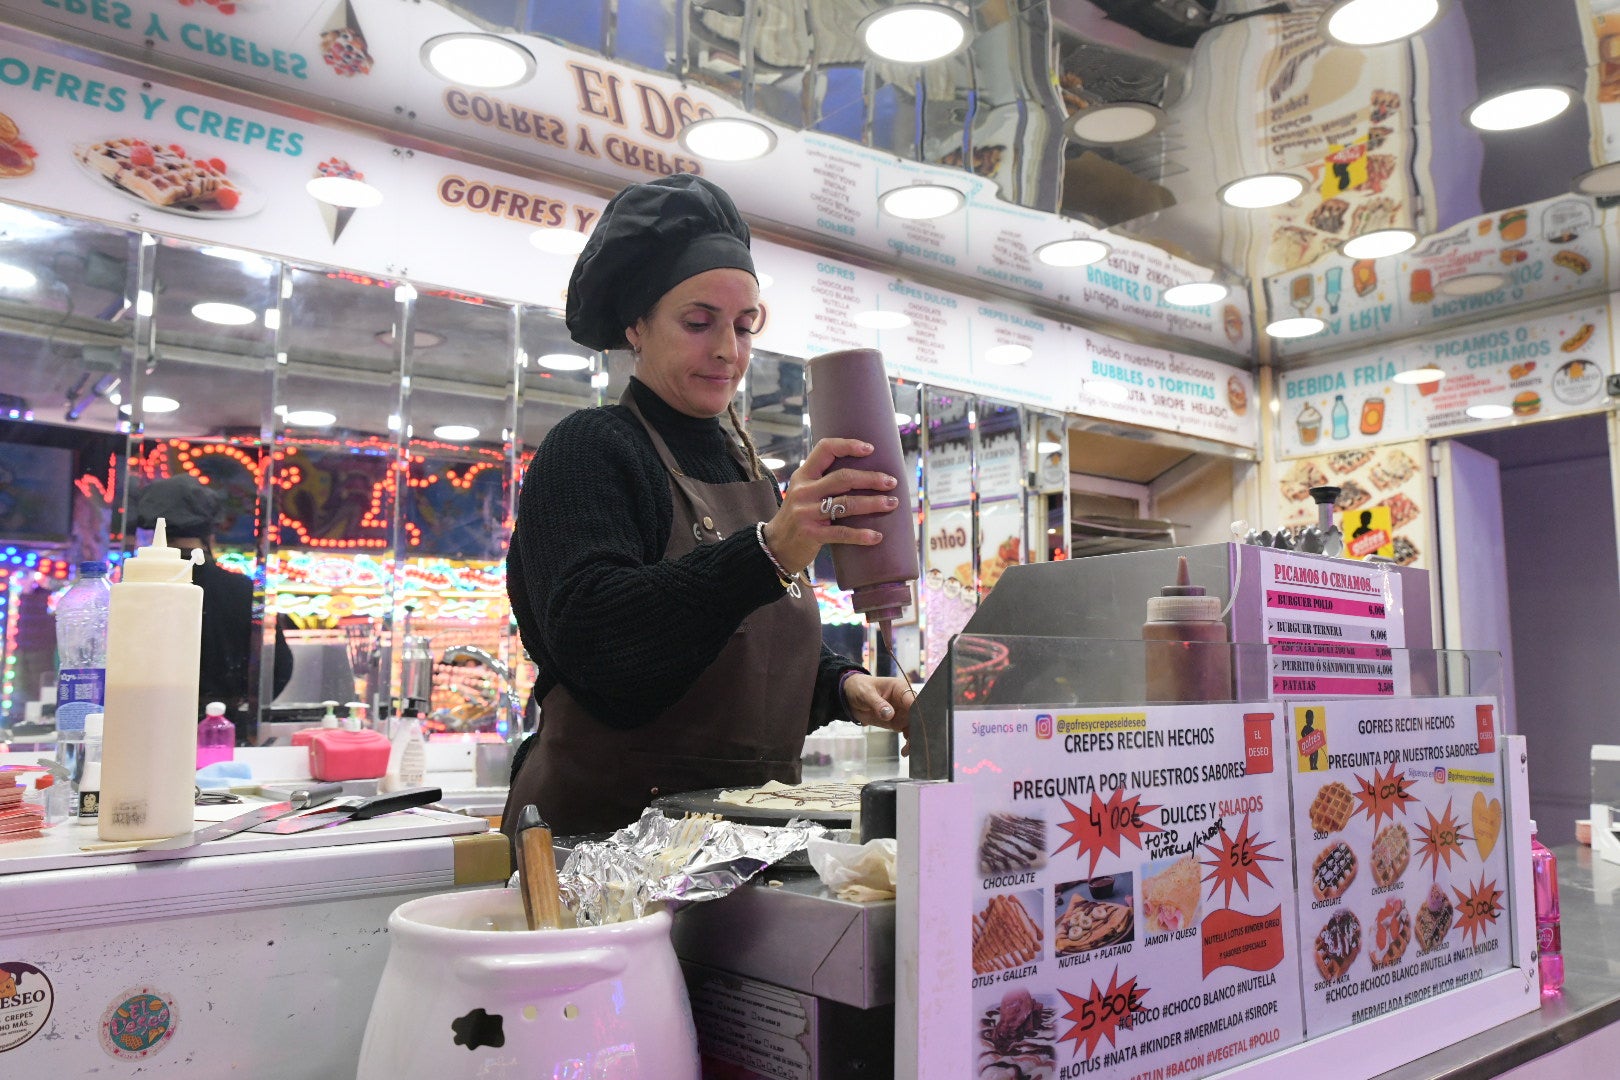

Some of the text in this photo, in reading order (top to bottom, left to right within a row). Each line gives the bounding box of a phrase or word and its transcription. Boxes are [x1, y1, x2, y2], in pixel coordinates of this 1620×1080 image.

[139, 94, 165, 120] Y
[174, 105, 304, 156] CREPES
[441, 178, 596, 234] GOFRES Y
[816, 262, 855, 281] GOFRES
[888, 283, 958, 309] CREPES DULCES
[1086, 339, 1121, 360] Prueba
[1124, 353, 1166, 371] nuestros
[1434, 327, 1528, 359] PICAMOS O
[1466, 340, 1552, 369] CENAMOS
[1092, 361, 1216, 400] BUBBLES TORTITAS
[1286, 355, 1397, 399] BEBIDA FRÍA
[1151, 394, 1186, 411] SIROPE
[1192, 398, 1229, 419] HELADO
[1274, 563, 1319, 584] PICAMOS
[1321, 571, 1328, 585] O
[1277, 594, 1312, 608] BURGUER
[1313, 599, 1333, 610] POLLO
[1277, 621, 1312, 634] BURGUER
[1313, 624, 1343, 637] TERNERA
[1281, 660, 1314, 672] PERRITO
[1282, 680, 1316, 691] PATATAS
[1017, 723, 1028, 733] en
[1254, 729, 1262, 740] EL
[1358, 716, 1455, 735] GOFRES RECIEN HECHOS
[1064, 727, 1215, 753] CREPES RECIEN HECHOS
[1248, 746, 1269, 758] DESEO
[1328, 742, 1479, 769] PREGUNTA POR NUESTROS SABORES
[1013, 761, 1245, 800] PREGUNTA POR NUESTROS SABORES
[1161, 795, 1264, 826] DULCES Y SALADOS
[1313, 831, 1329, 841] SOLO
[983, 872, 1036, 890] CHOCOLATE
[1312, 896, 1342, 910] CHOCOLATE
[1144, 927, 1198, 948] JAMON Y QUESO
[1204, 918, 1281, 946] NUTELLA LOTUS KINDER OREO
[1058, 952, 1092, 969] NUTELLA
[1100, 943, 1133, 960] PLATANO
[1003, 965, 1038, 982] GALLETA
[1325, 938, 1499, 1004] #CHOCO #CHOCO BLANCO #NUTELLA #NATA #KINDER
[1118, 972, 1277, 1031] #CHOCO #CHOCO BLANCO #NUTELLA
[1352, 996, 1403, 1025] #MERMELADA
[1404, 985, 1431, 1006] #SIROPE
[5, 1011, 33, 1022] CREPES
[1059, 1000, 1278, 1080] #LOTUS #NATA #KINDER #MERMELADA #SIROPE
[1166, 1055, 1205, 1078] #BACON
[1206, 1040, 1248, 1066] #VEGETAL
[1249, 1028, 1280, 1051] #POLLO
